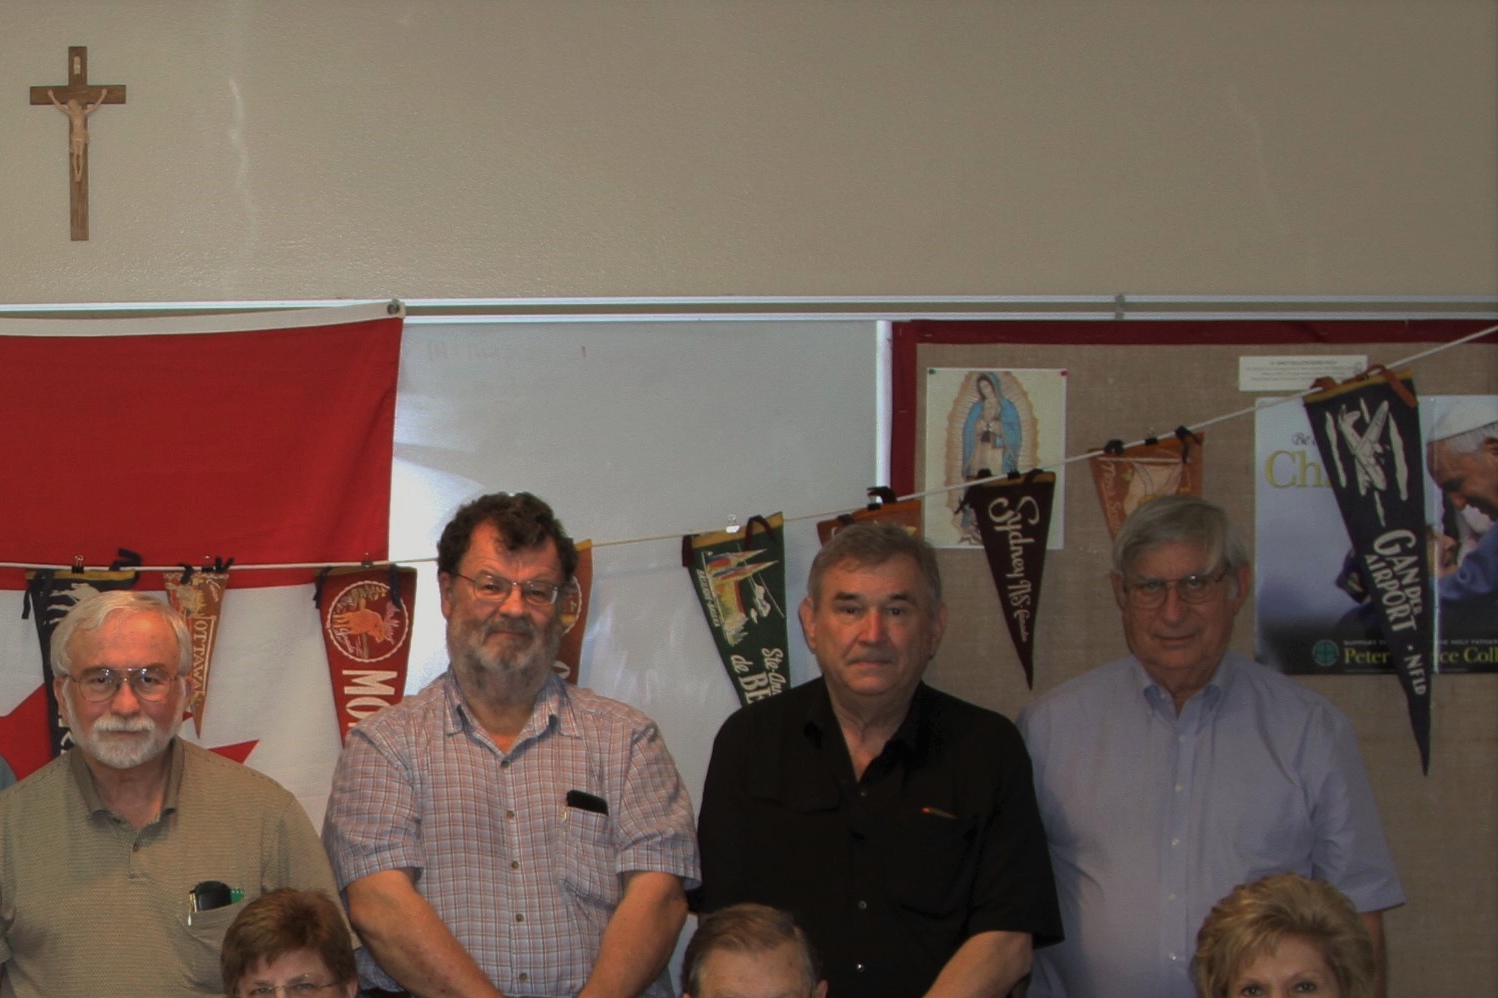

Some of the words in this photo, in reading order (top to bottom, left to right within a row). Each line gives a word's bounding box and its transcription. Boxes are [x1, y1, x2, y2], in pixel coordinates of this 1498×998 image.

[987, 495, 1040, 578] Sydney
[1373, 528, 1423, 615] GANDER
[1363, 554, 1418, 632] AIRPORT
[192, 620, 209, 690] OTTAWA
[730, 654, 754, 673] de
[1343, 647, 1391, 664] Peter
[342, 669, 398, 728] MO
